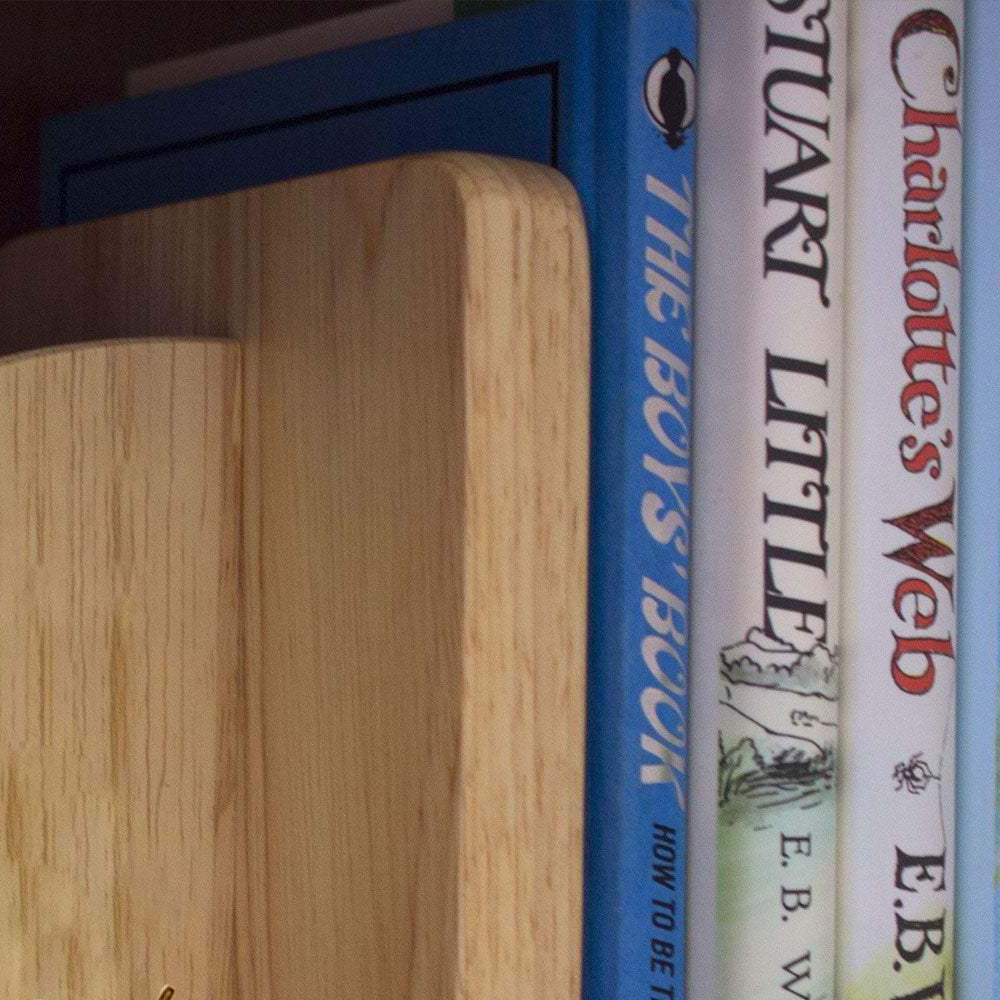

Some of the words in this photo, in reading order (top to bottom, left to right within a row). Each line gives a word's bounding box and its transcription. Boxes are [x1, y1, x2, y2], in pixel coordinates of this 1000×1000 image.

[643, 174, 694, 342] THE
[890, 8, 961, 480] Charlotte's
[763, 348, 829, 644] LITTLE
[881, 477, 957, 696] Web
[639, 576, 689, 812] BOOK
[652, 823, 677, 891] HOW
[780, 832, 812, 868] E.
[780, 885, 812, 922] B.
[650, 899, 676, 932] TO
[650, 937, 675, 978] BE
